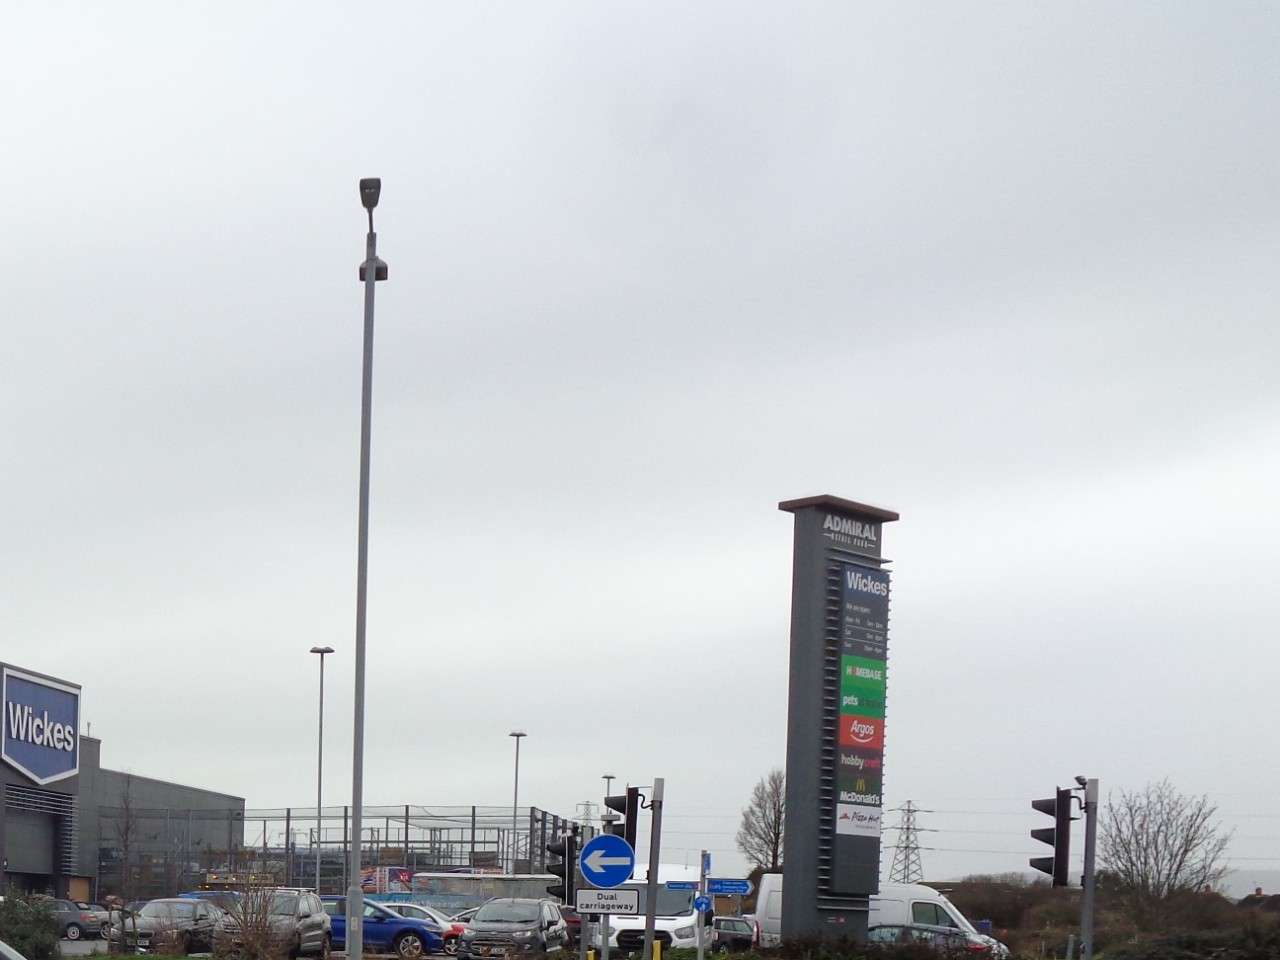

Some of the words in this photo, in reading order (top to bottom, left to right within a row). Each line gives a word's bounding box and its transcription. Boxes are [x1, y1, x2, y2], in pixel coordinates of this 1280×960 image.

[823, 514, 876, 541] ADMIRAL
[847, 571, 887, 596] Wickes
[8, 701, 74, 752] Wickes
[850, 720, 874, 736] Argos
[840, 790, 880, 804] McDonald's
[597, 893, 618, 901] Dual
[579, 902, 634, 911] carriageway
